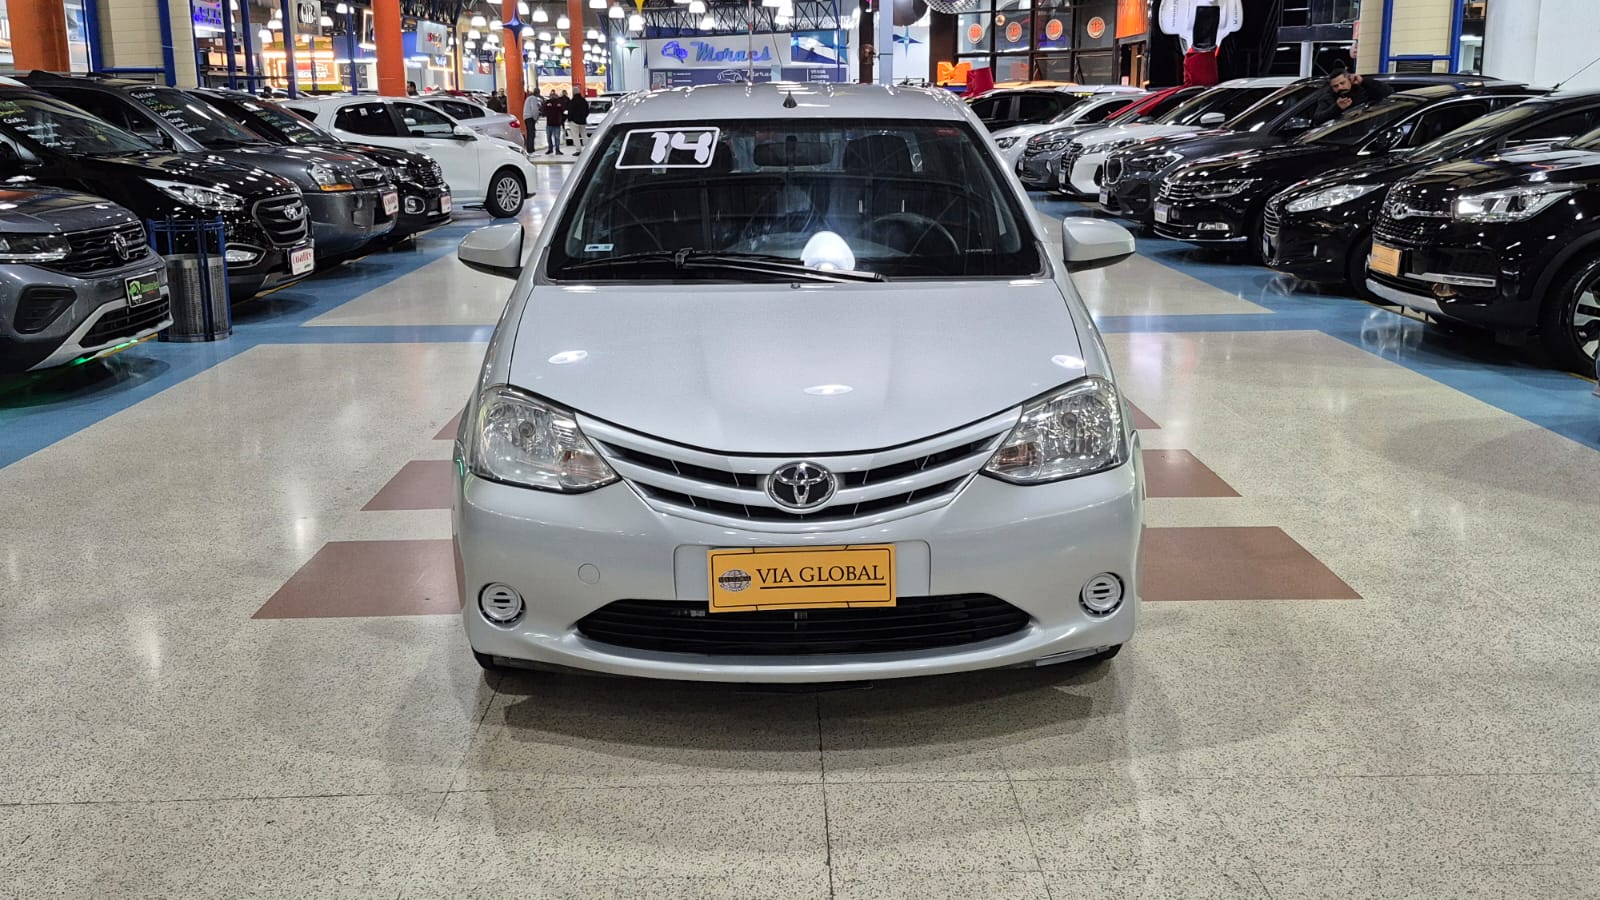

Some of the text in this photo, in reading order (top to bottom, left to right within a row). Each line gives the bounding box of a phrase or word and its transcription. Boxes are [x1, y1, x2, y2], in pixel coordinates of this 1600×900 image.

[690, 41, 772, 62] Moraes
[650, 131, 713, 164] 14
[756, 567, 793, 584] VIA
[799, 565, 885, 583] GLOBAL
